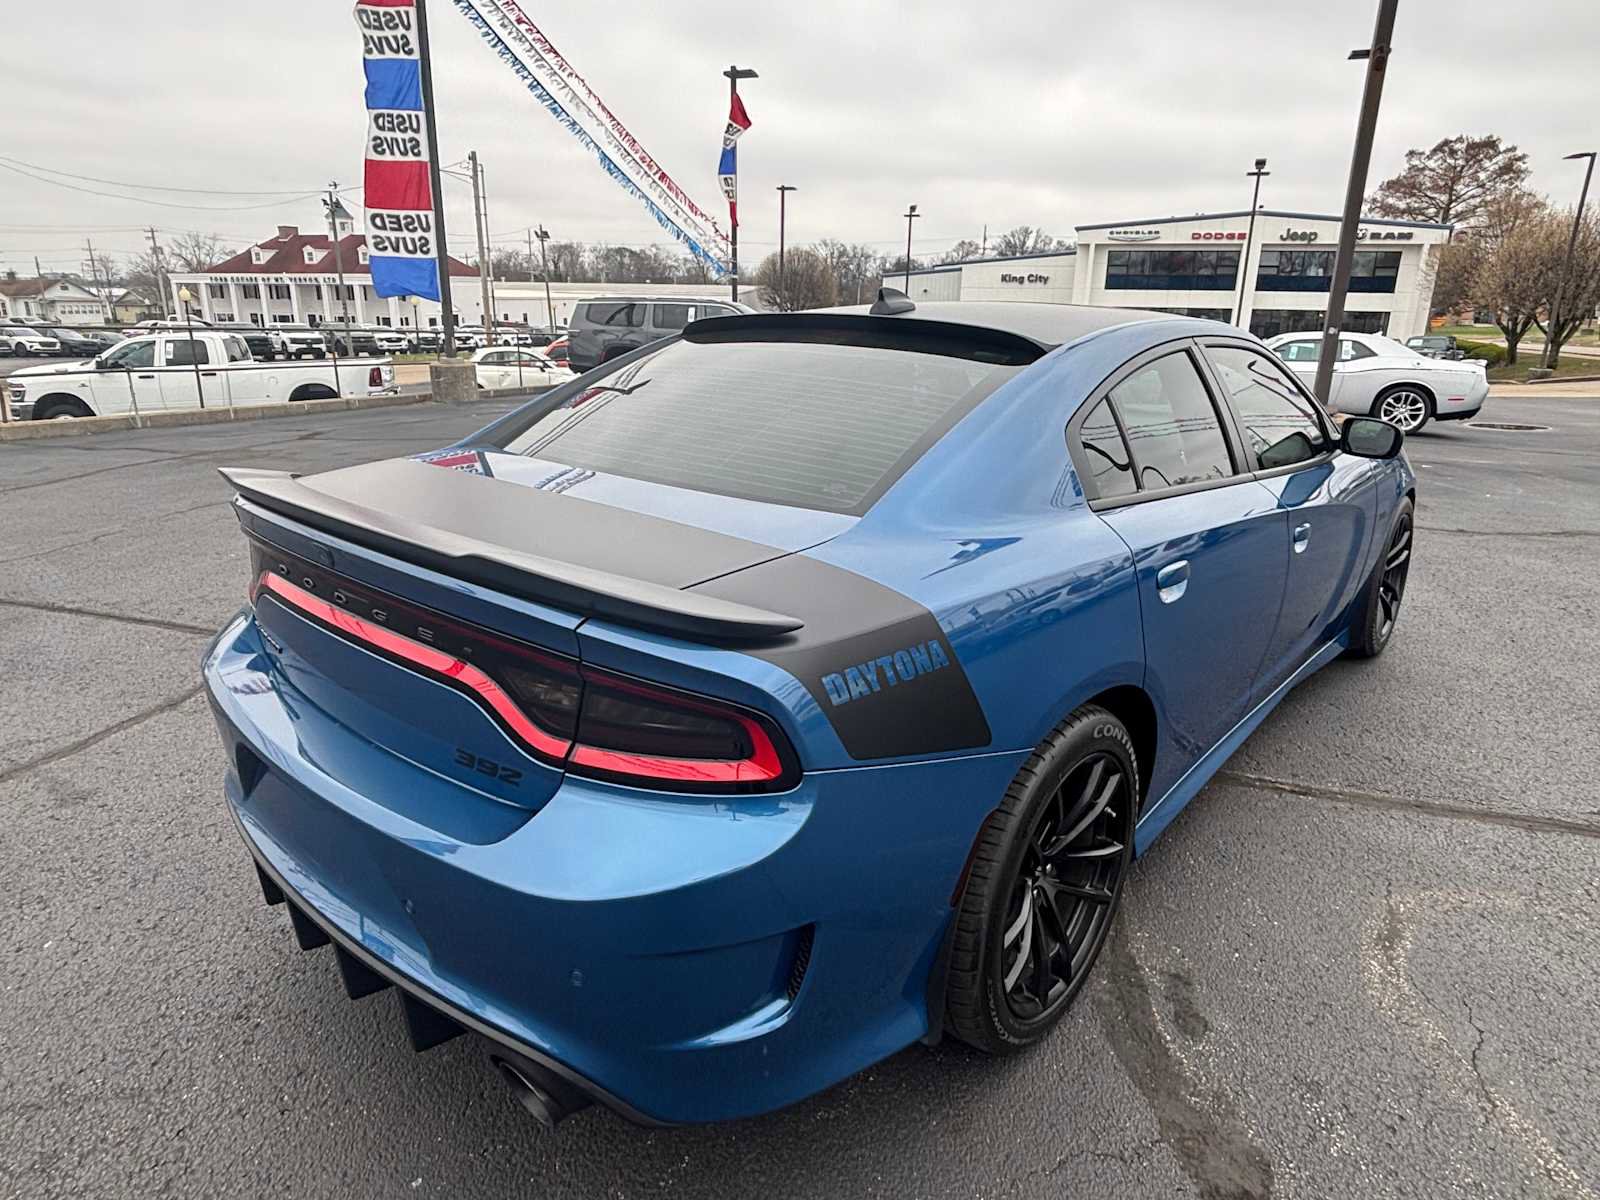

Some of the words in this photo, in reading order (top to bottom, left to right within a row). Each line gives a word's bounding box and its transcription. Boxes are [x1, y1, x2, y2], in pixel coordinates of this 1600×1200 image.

[1191, 232, 1247, 240] DODGE
[1280, 228, 1318, 244] Jeep
[1369, 232, 1414, 240] RAM
[1001, 273, 1025, 285] King
[1027, 273, 1049, 285] City
[278, 563, 434, 642] DODGE
[821, 639, 950, 706] DAYTONA
[455, 747, 523, 787] 392
